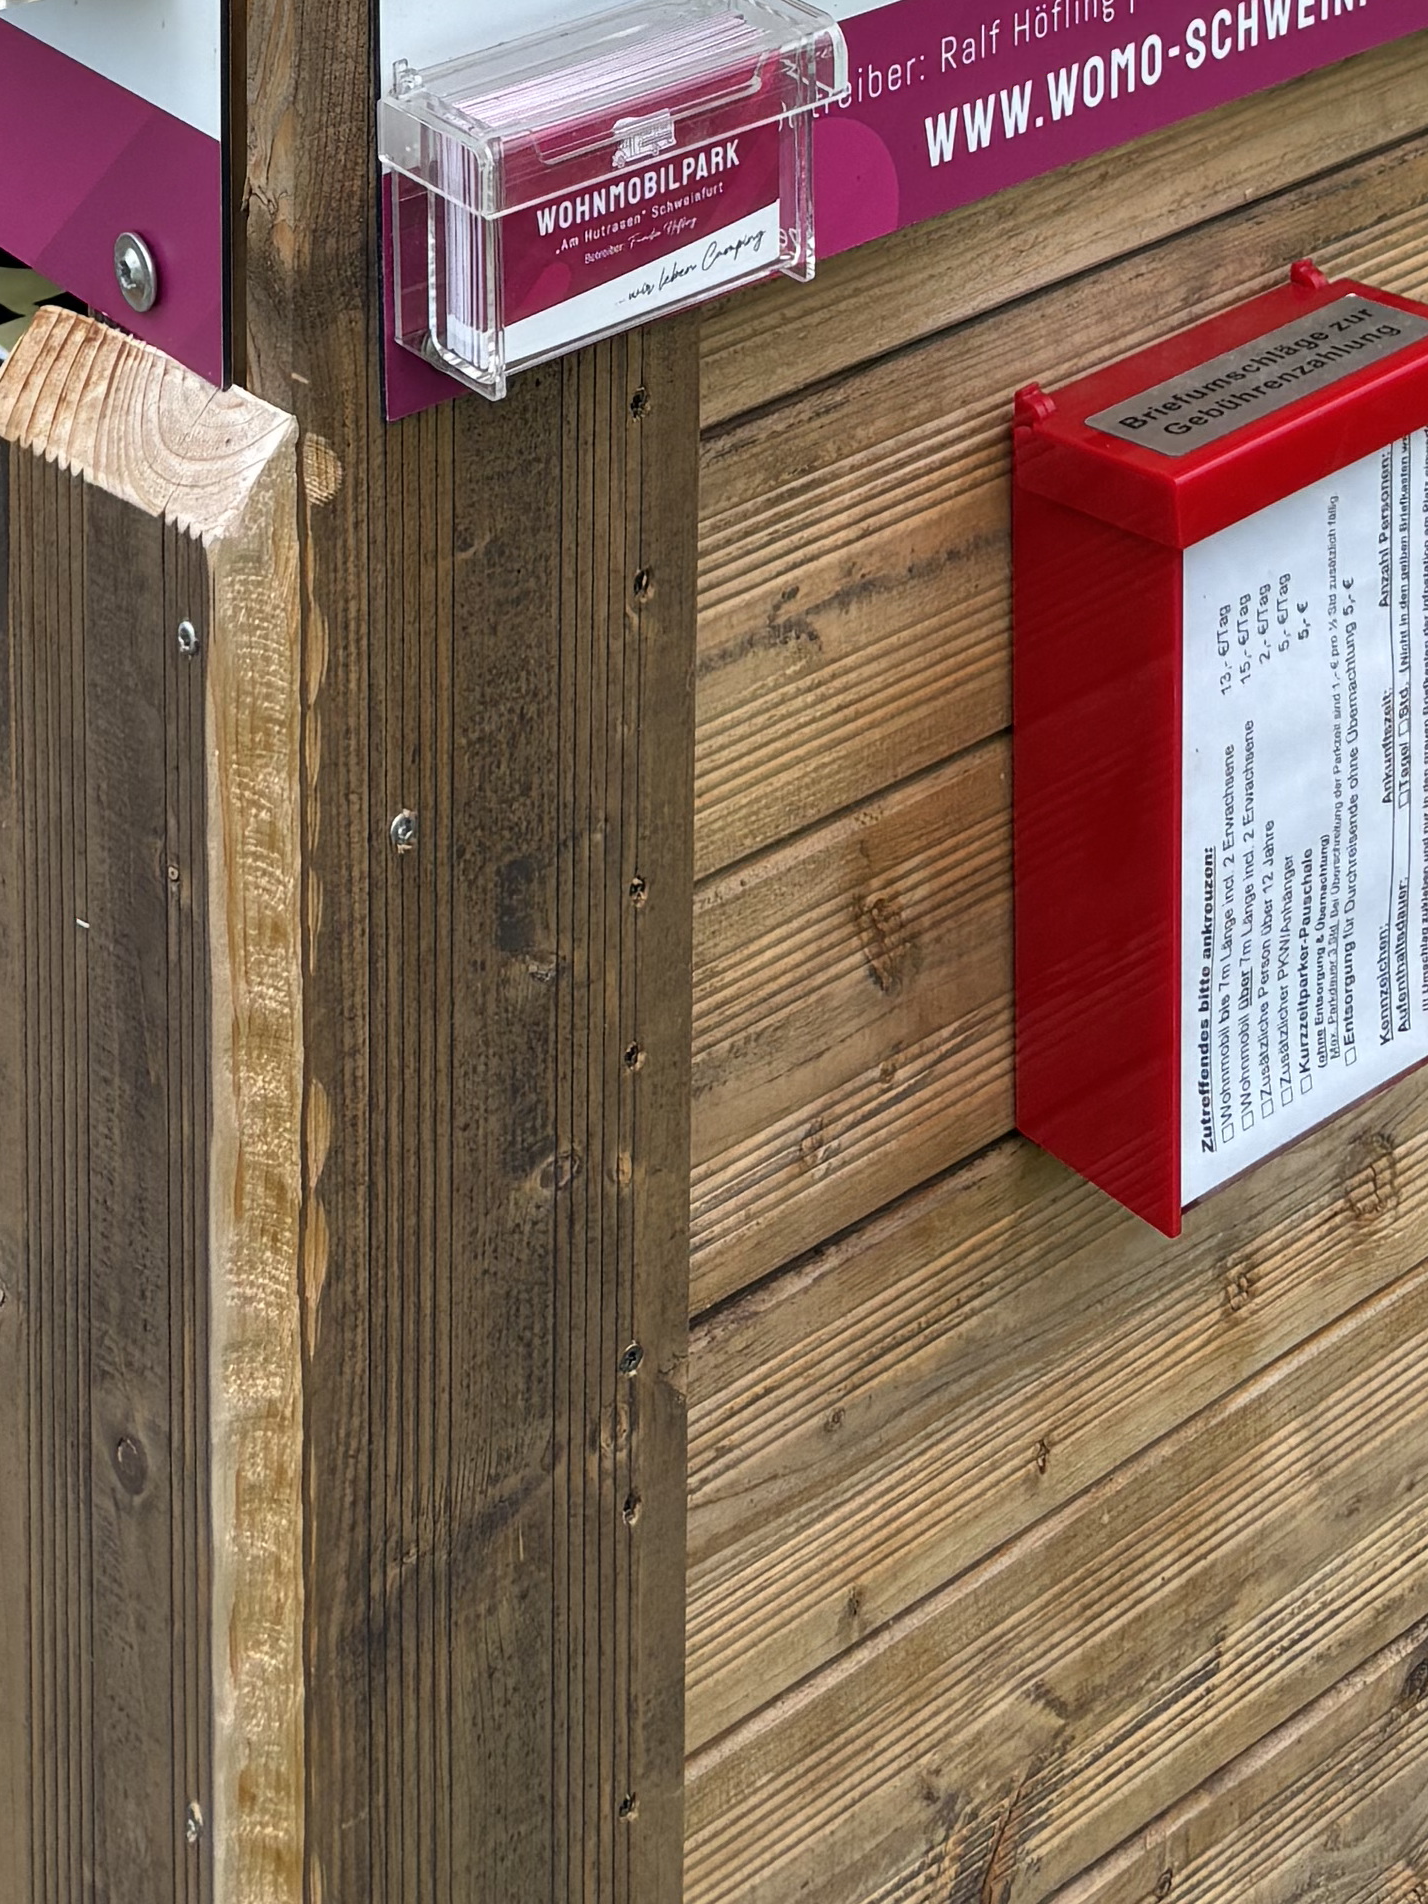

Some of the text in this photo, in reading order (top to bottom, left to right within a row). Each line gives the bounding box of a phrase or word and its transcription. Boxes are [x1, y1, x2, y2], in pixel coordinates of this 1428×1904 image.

[939, 19, 1001, 75] Ralf
[536, 139, 741, 237] WOHNMOBILPARK
[1118, 306, 1375, 430] Briefumschläge zur
[1163, 321, 1402, 437] Gebührenzahlung
[1217, 604, 1232, 656] €/Tag
[1219, 660, 1233, 695] 13,-
[1222, 744, 1236, 848] Erwachsene
[1343, 578, 1359, 1045] Entsorgung für Durchreisende ohne Übernachtung 5,- €
[1223, 854, 1235, 866] 2
[1219, 964, 1231, 989] 7m
[1220, 910, 1236, 960] Länge
[1297, 848, 1314, 1074] Kurzzeitparker-Pauschale
[1198, 847, 1215, 1153] Zutreffendes bitte ankreuzen:
[1218, 995, 1231, 1020] bis
[1217, 1026, 1232, 1124] Wohnmobil
